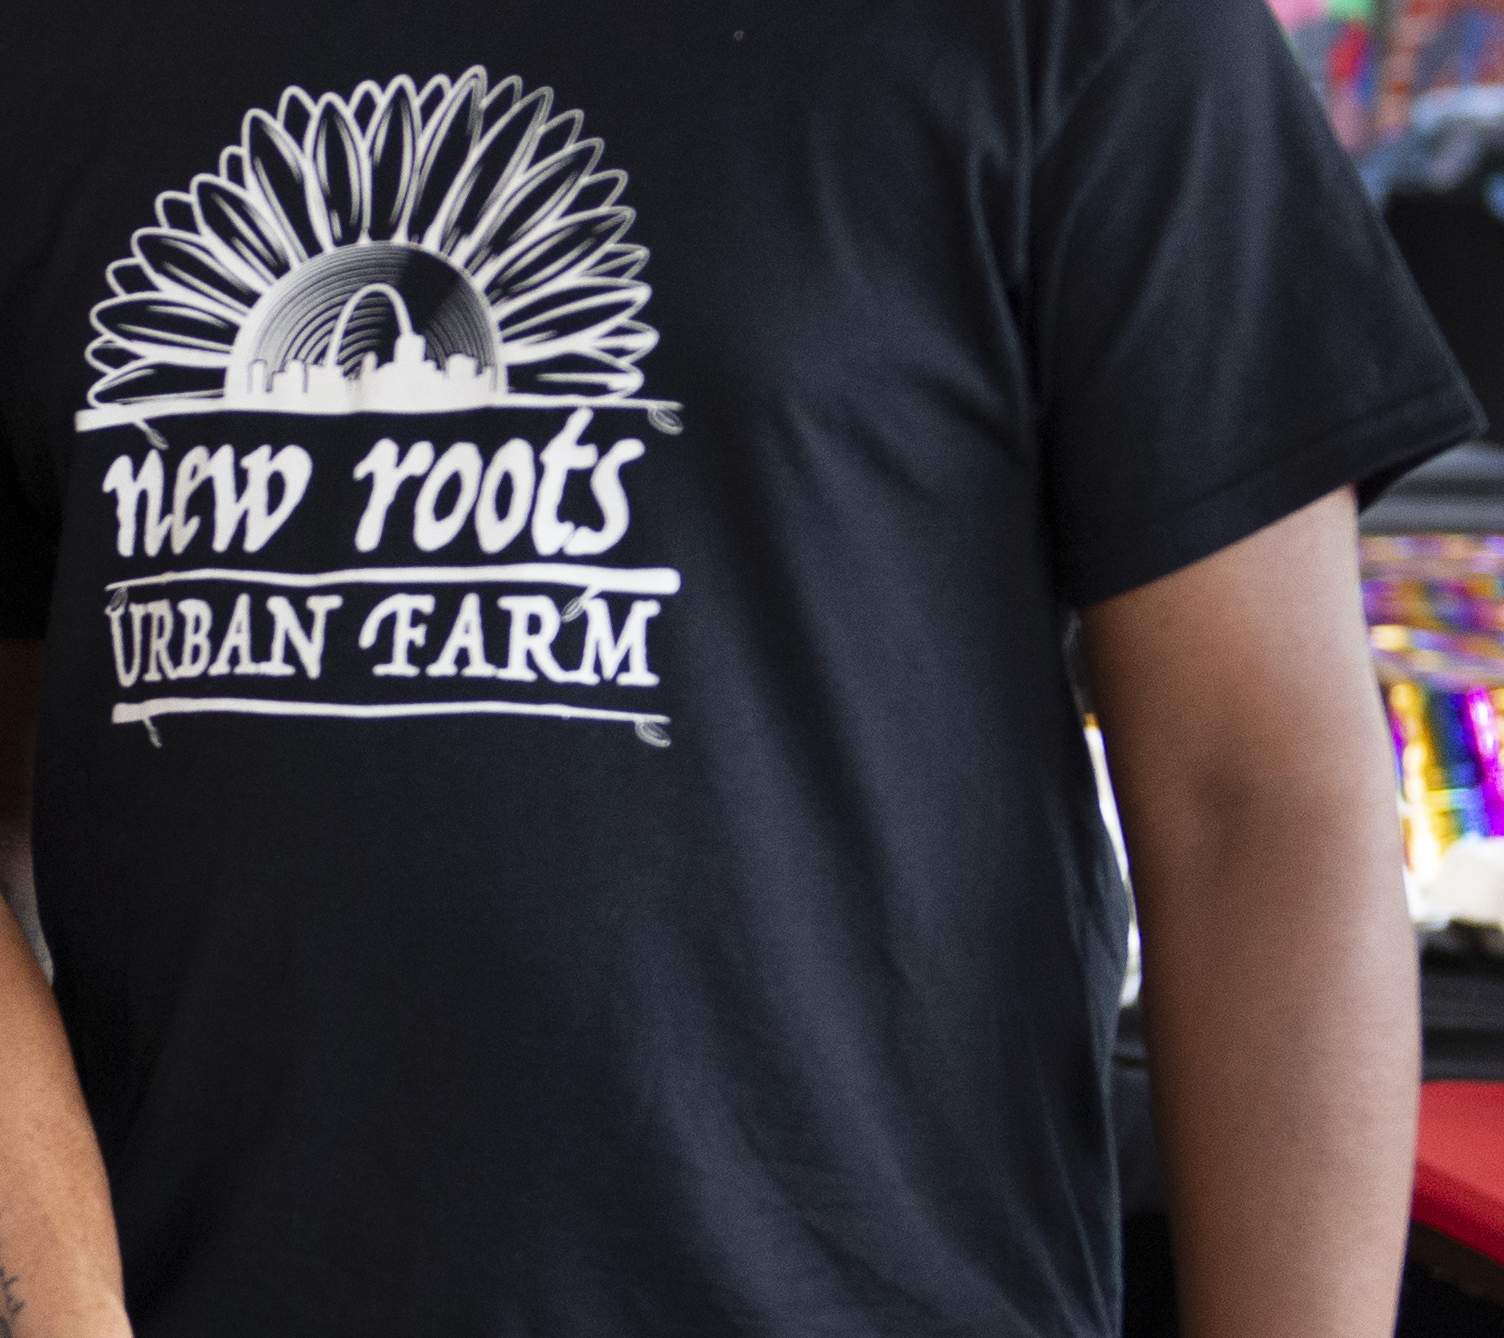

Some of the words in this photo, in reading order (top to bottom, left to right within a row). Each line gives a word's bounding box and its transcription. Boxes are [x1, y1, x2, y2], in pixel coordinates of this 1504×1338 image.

[103, 444, 313, 557] new
[353, 408, 645, 557] roots
[106, 593, 342, 688] URBAN
[358, 592, 663, 687] FARM
